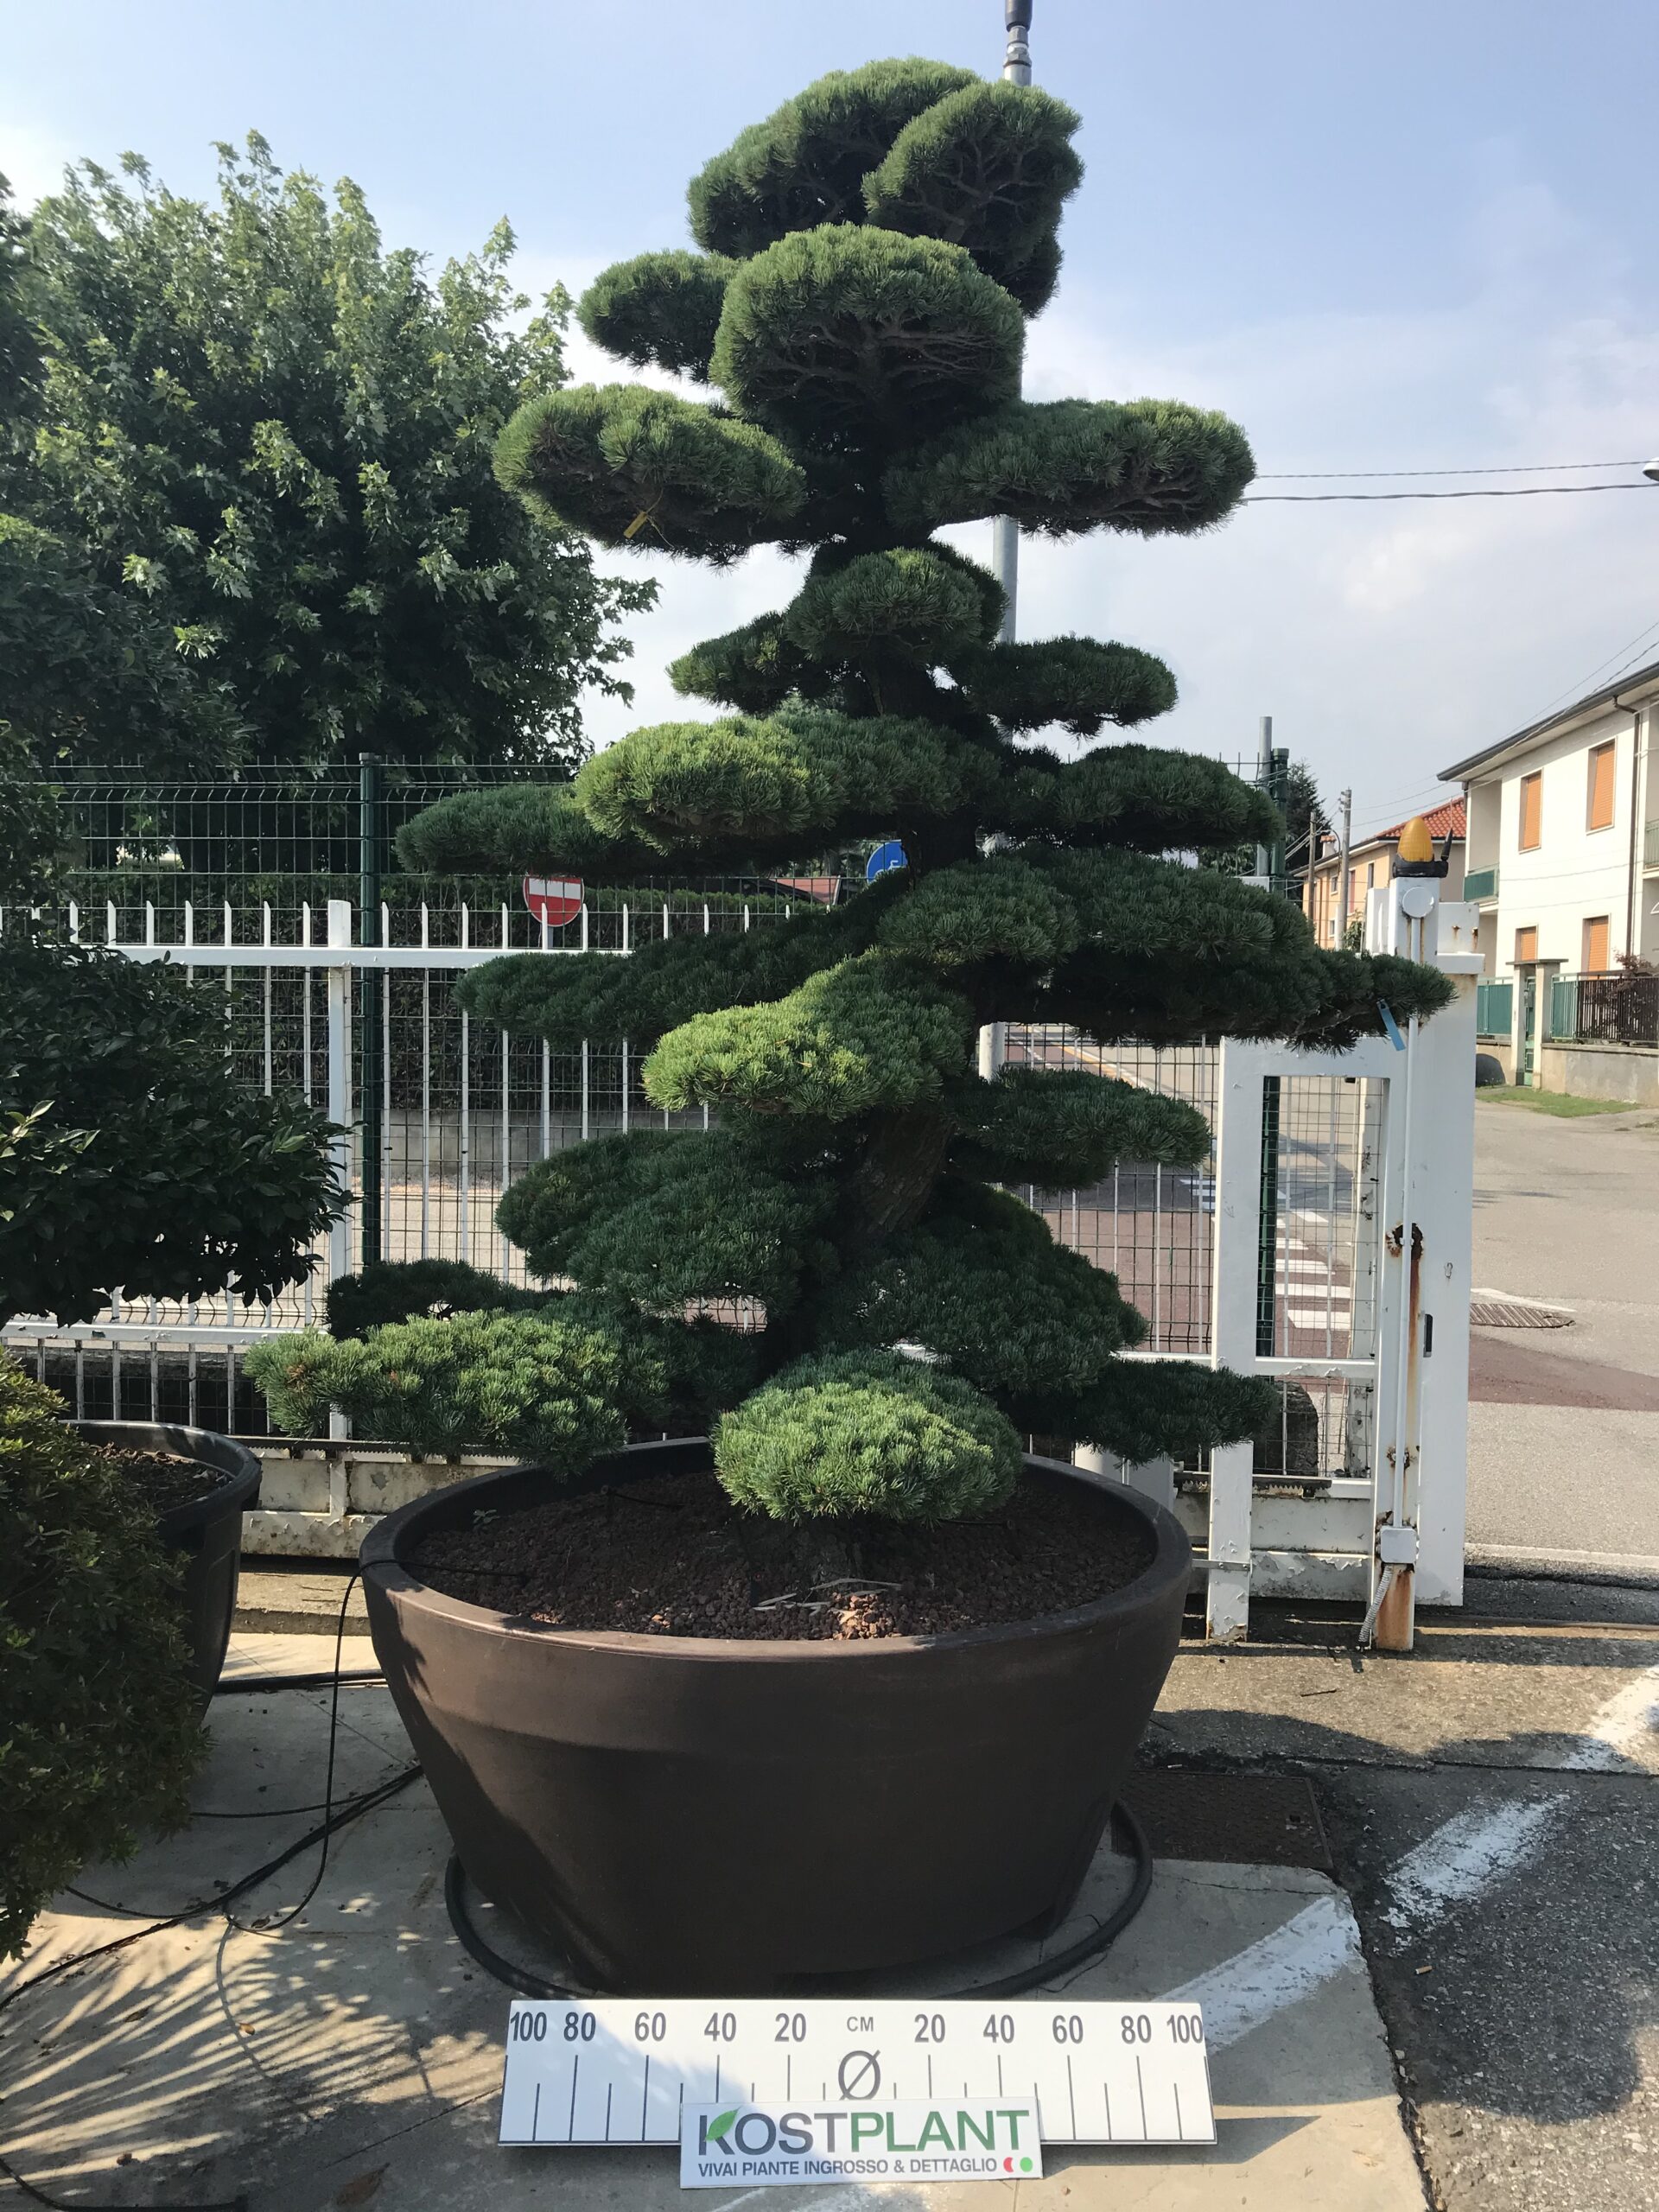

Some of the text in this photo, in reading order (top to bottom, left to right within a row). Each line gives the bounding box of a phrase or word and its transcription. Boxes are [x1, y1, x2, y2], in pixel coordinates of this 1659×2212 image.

[510, 2012, 1204, 2044] 100 80 60 40 20 CM 20 40 60 80 100
[698, 2109, 1030, 2156] KOSTPLANT
[698, 2158, 997, 2177] VIVAI PIANTE INGROSSO & DETTAGLIO
